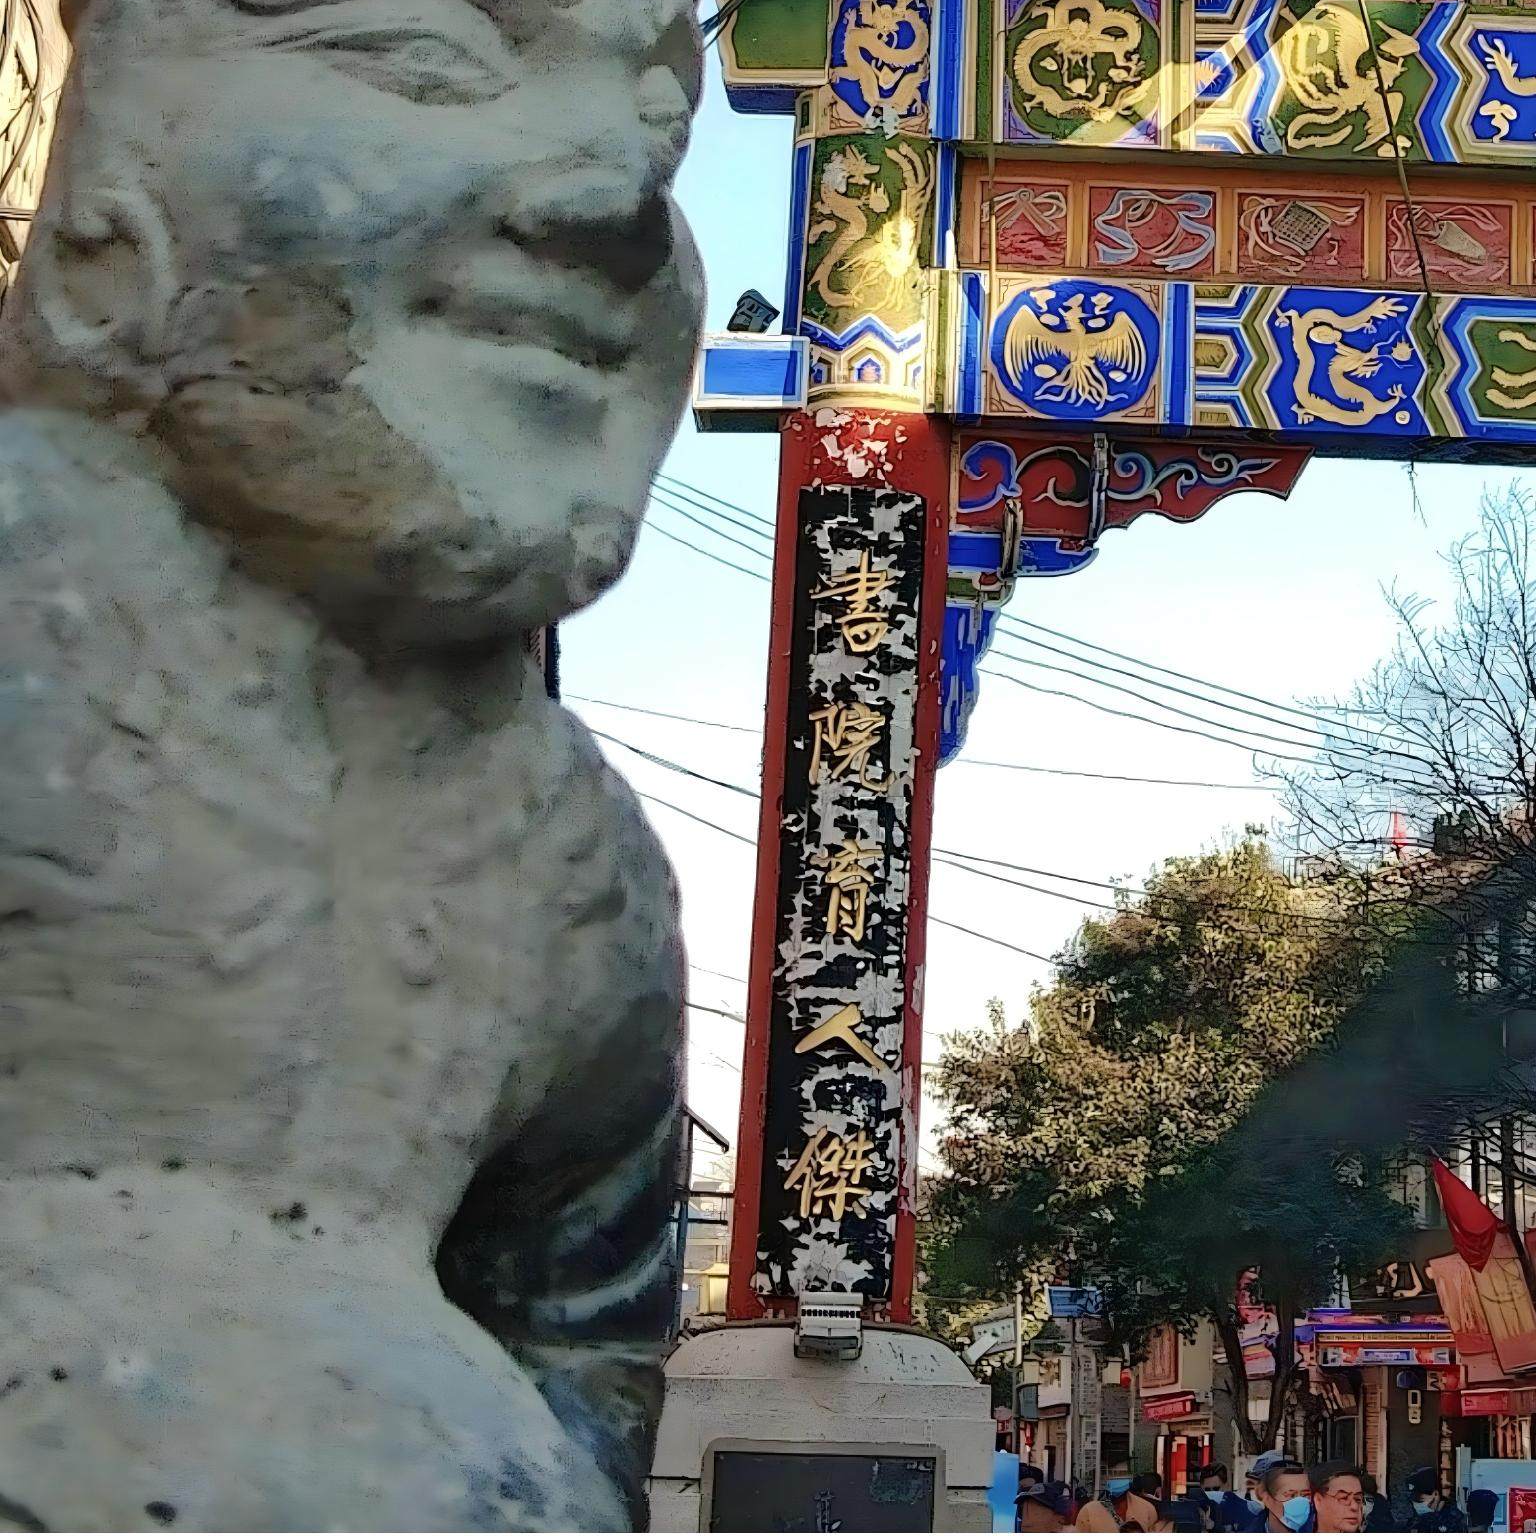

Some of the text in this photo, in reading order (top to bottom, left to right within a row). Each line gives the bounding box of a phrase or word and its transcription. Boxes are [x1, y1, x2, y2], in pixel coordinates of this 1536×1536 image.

[785, 548, 896, 1221] 書院育人傑
